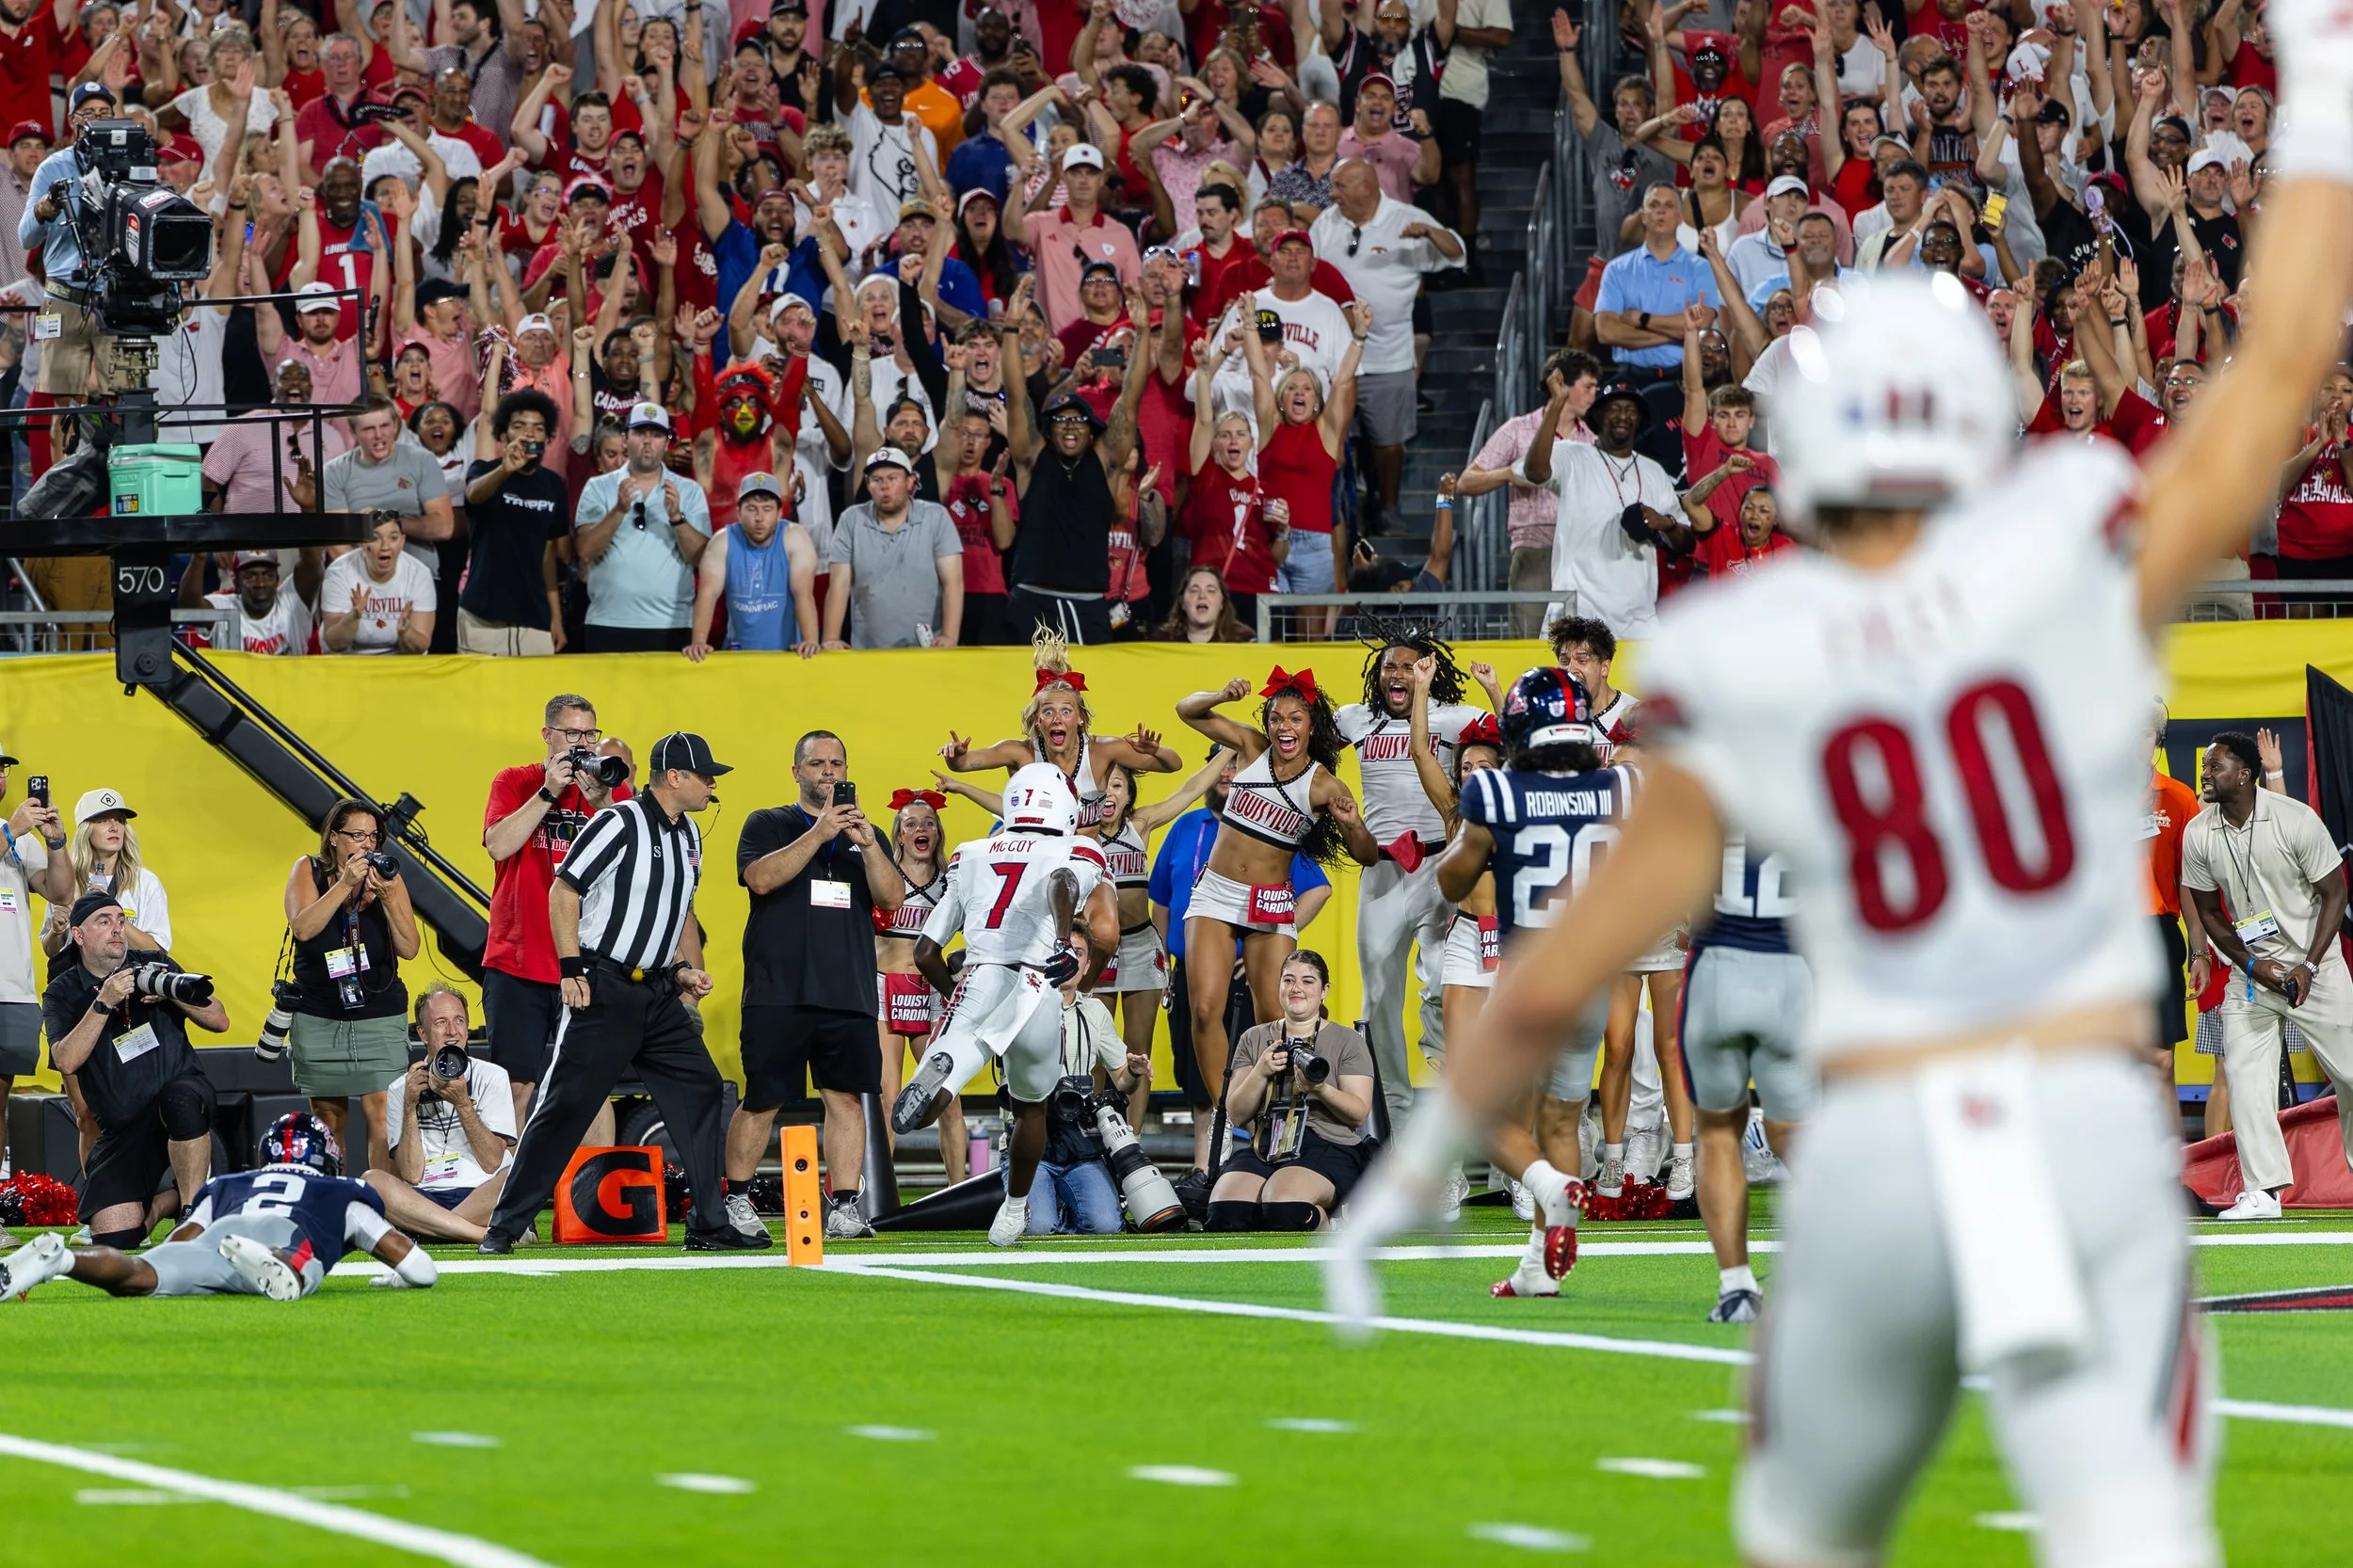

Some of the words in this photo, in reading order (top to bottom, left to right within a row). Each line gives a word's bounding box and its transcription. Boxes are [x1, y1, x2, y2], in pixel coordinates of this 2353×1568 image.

[118, 566, 165, 594] 570
[1024, 789, 1034, 807] 7
[1229, 788, 1305, 837] LOUISVILLE
[1525, 791, 1596, 818] ROBINSON
[1597, 789, 1612, 816] III
[1820, 674, 2077, 934] 80
[653, 845, 663, 858] S
[989, 840, 1036, 854] McCOY
[984, 861, 1029, 930] 7
[241, 1172, 307, 1218] 2
[570, 1150, 660, 1236] G
